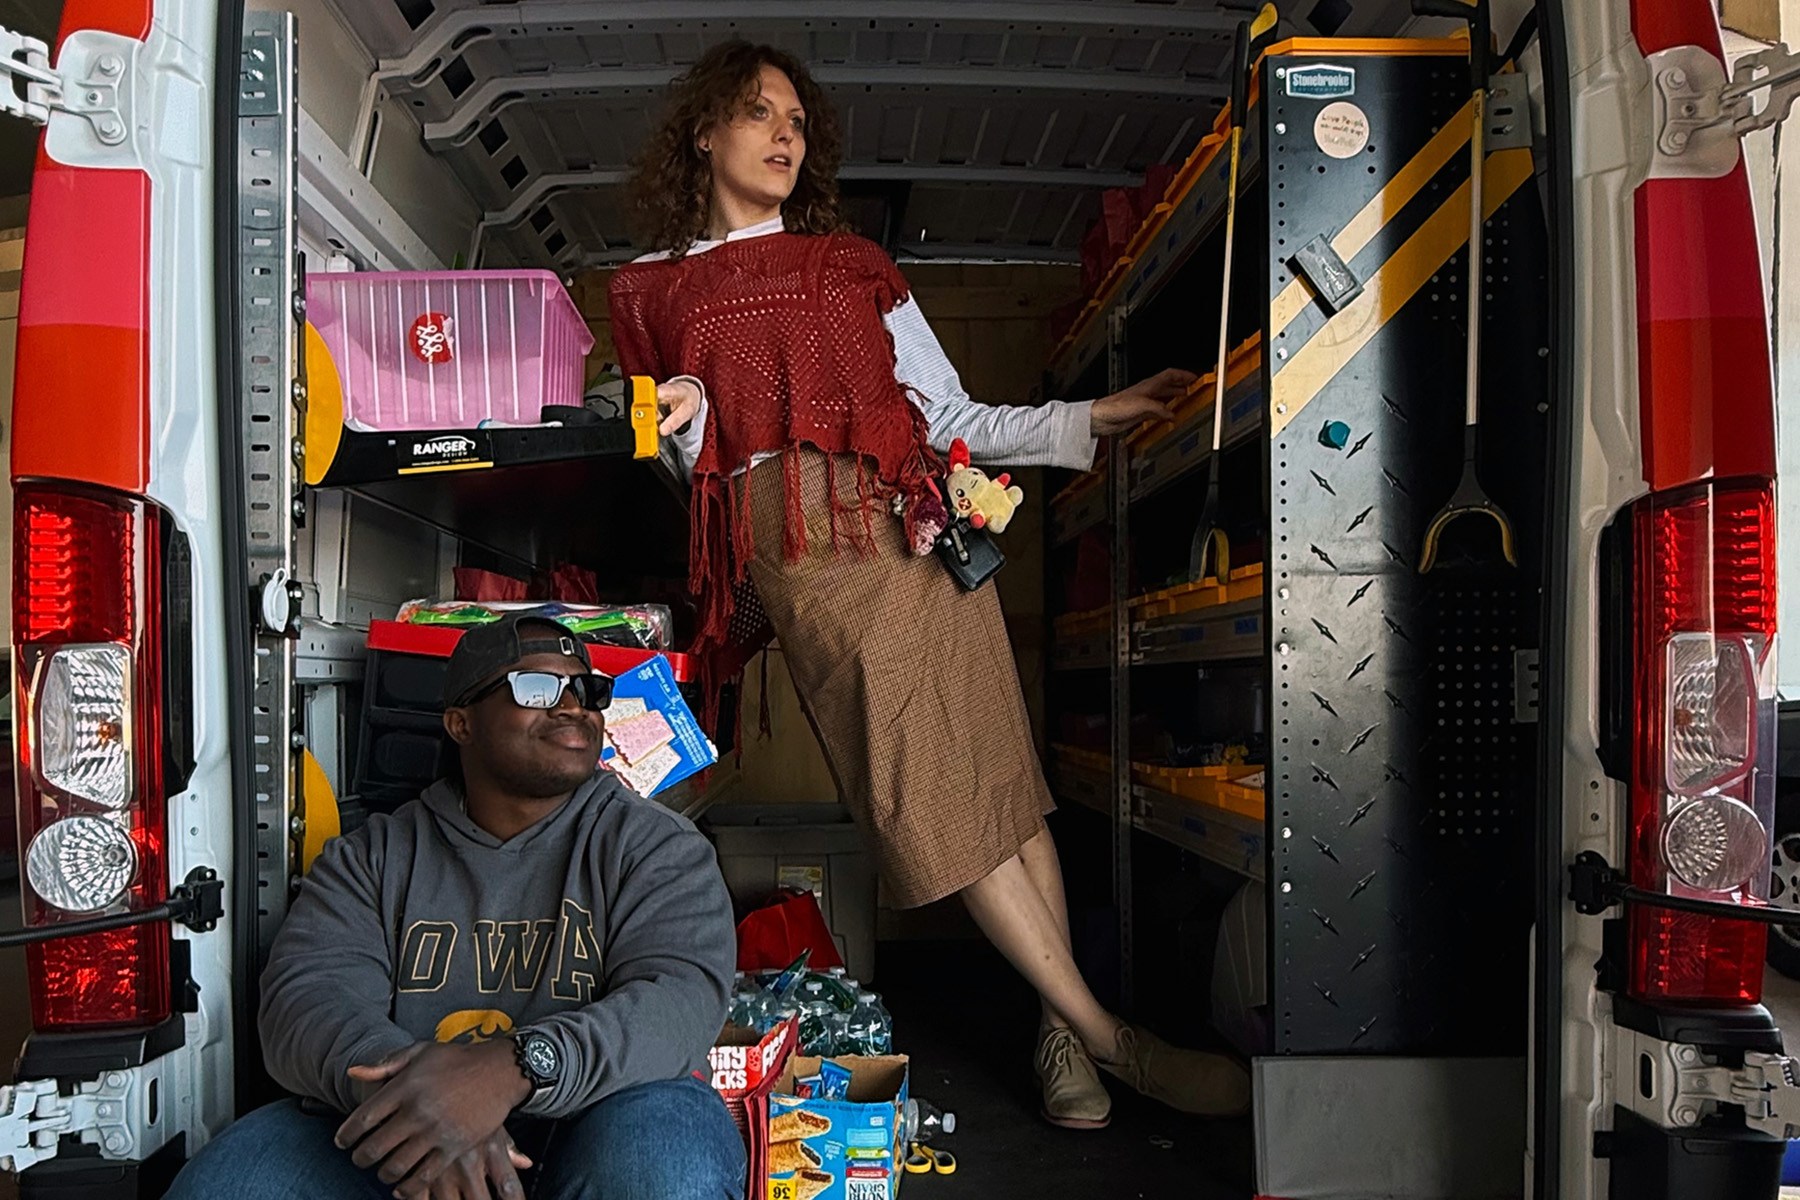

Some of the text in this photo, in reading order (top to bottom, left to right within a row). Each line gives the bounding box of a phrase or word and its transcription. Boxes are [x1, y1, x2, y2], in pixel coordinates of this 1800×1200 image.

[1292, 73, 1349, 86] Stonebrooke
[413, 441, 467, 455] RANGER
[391, 898, 605, 1002] OWA
[773, 1186, 791, 1199] 36
[848, 1183, 885, 1193] GRAIN
